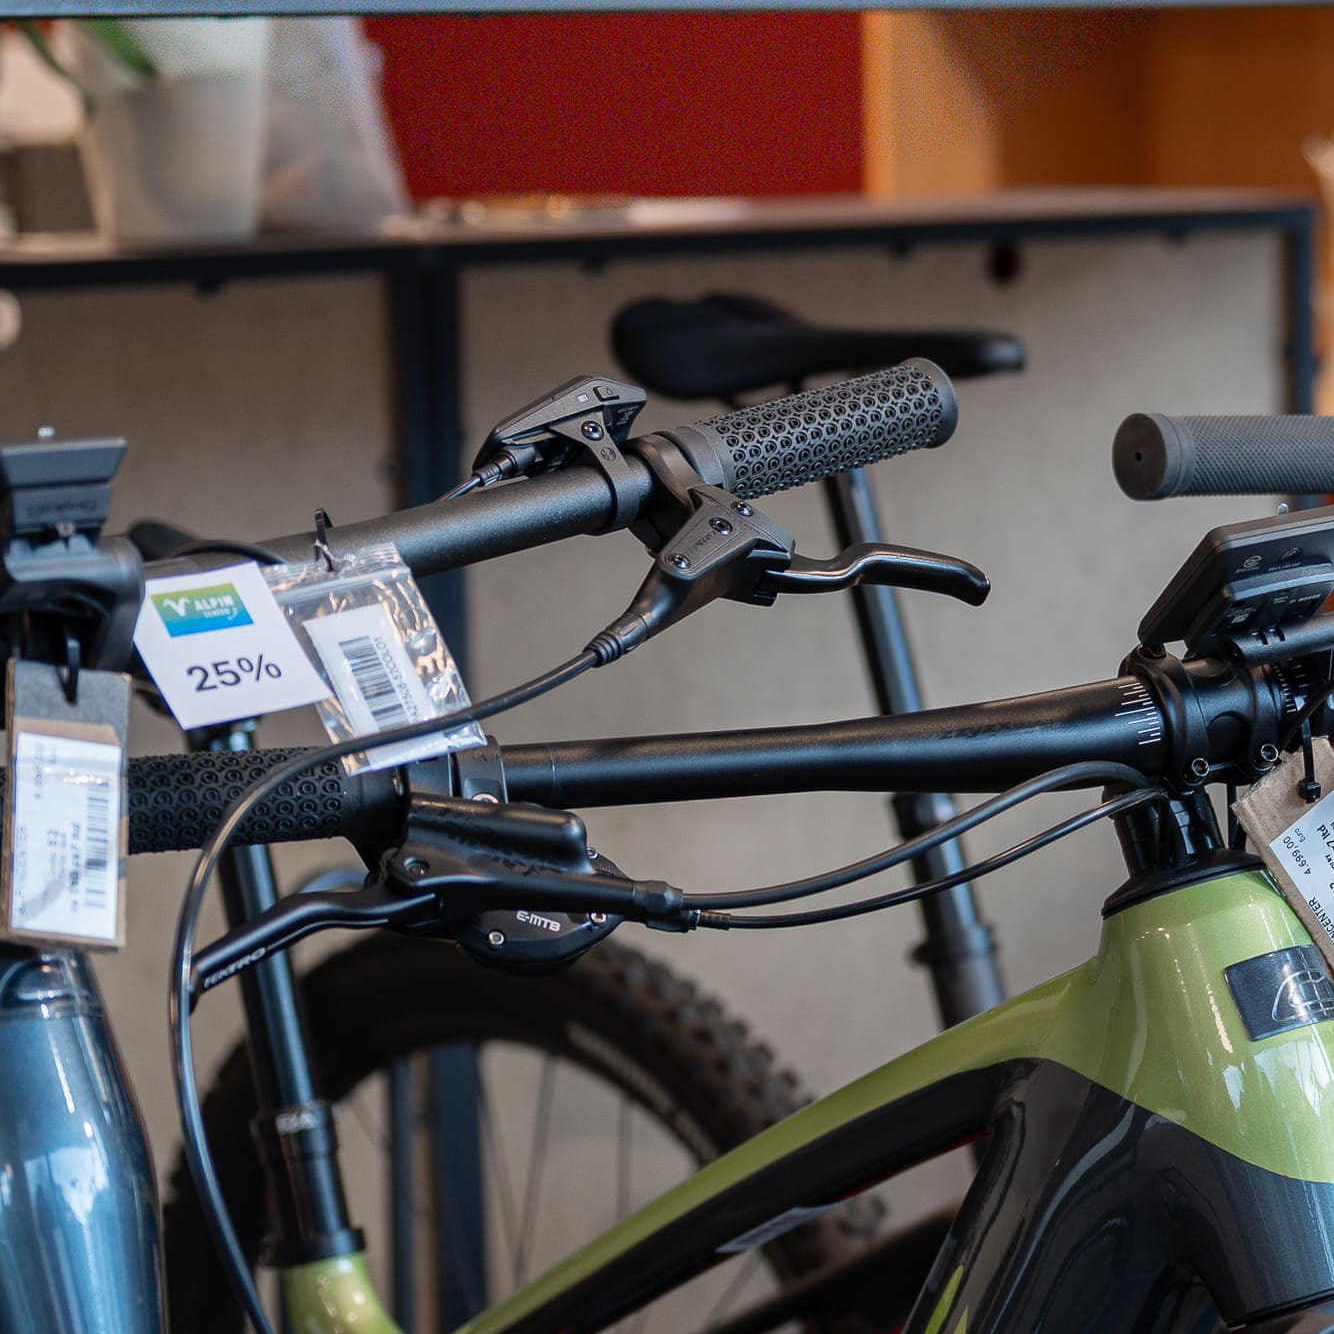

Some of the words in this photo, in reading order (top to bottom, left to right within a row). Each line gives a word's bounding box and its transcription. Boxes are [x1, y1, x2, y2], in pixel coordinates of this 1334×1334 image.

[186, 654, 283, 692] 25%
[1293, 827, 1306, 844] Euro
[1282, 834, 1312, 876] 4.699,00
[515, 910, 561, 932] E-MTB
[203, 946, 267, 989] TEKTRO
